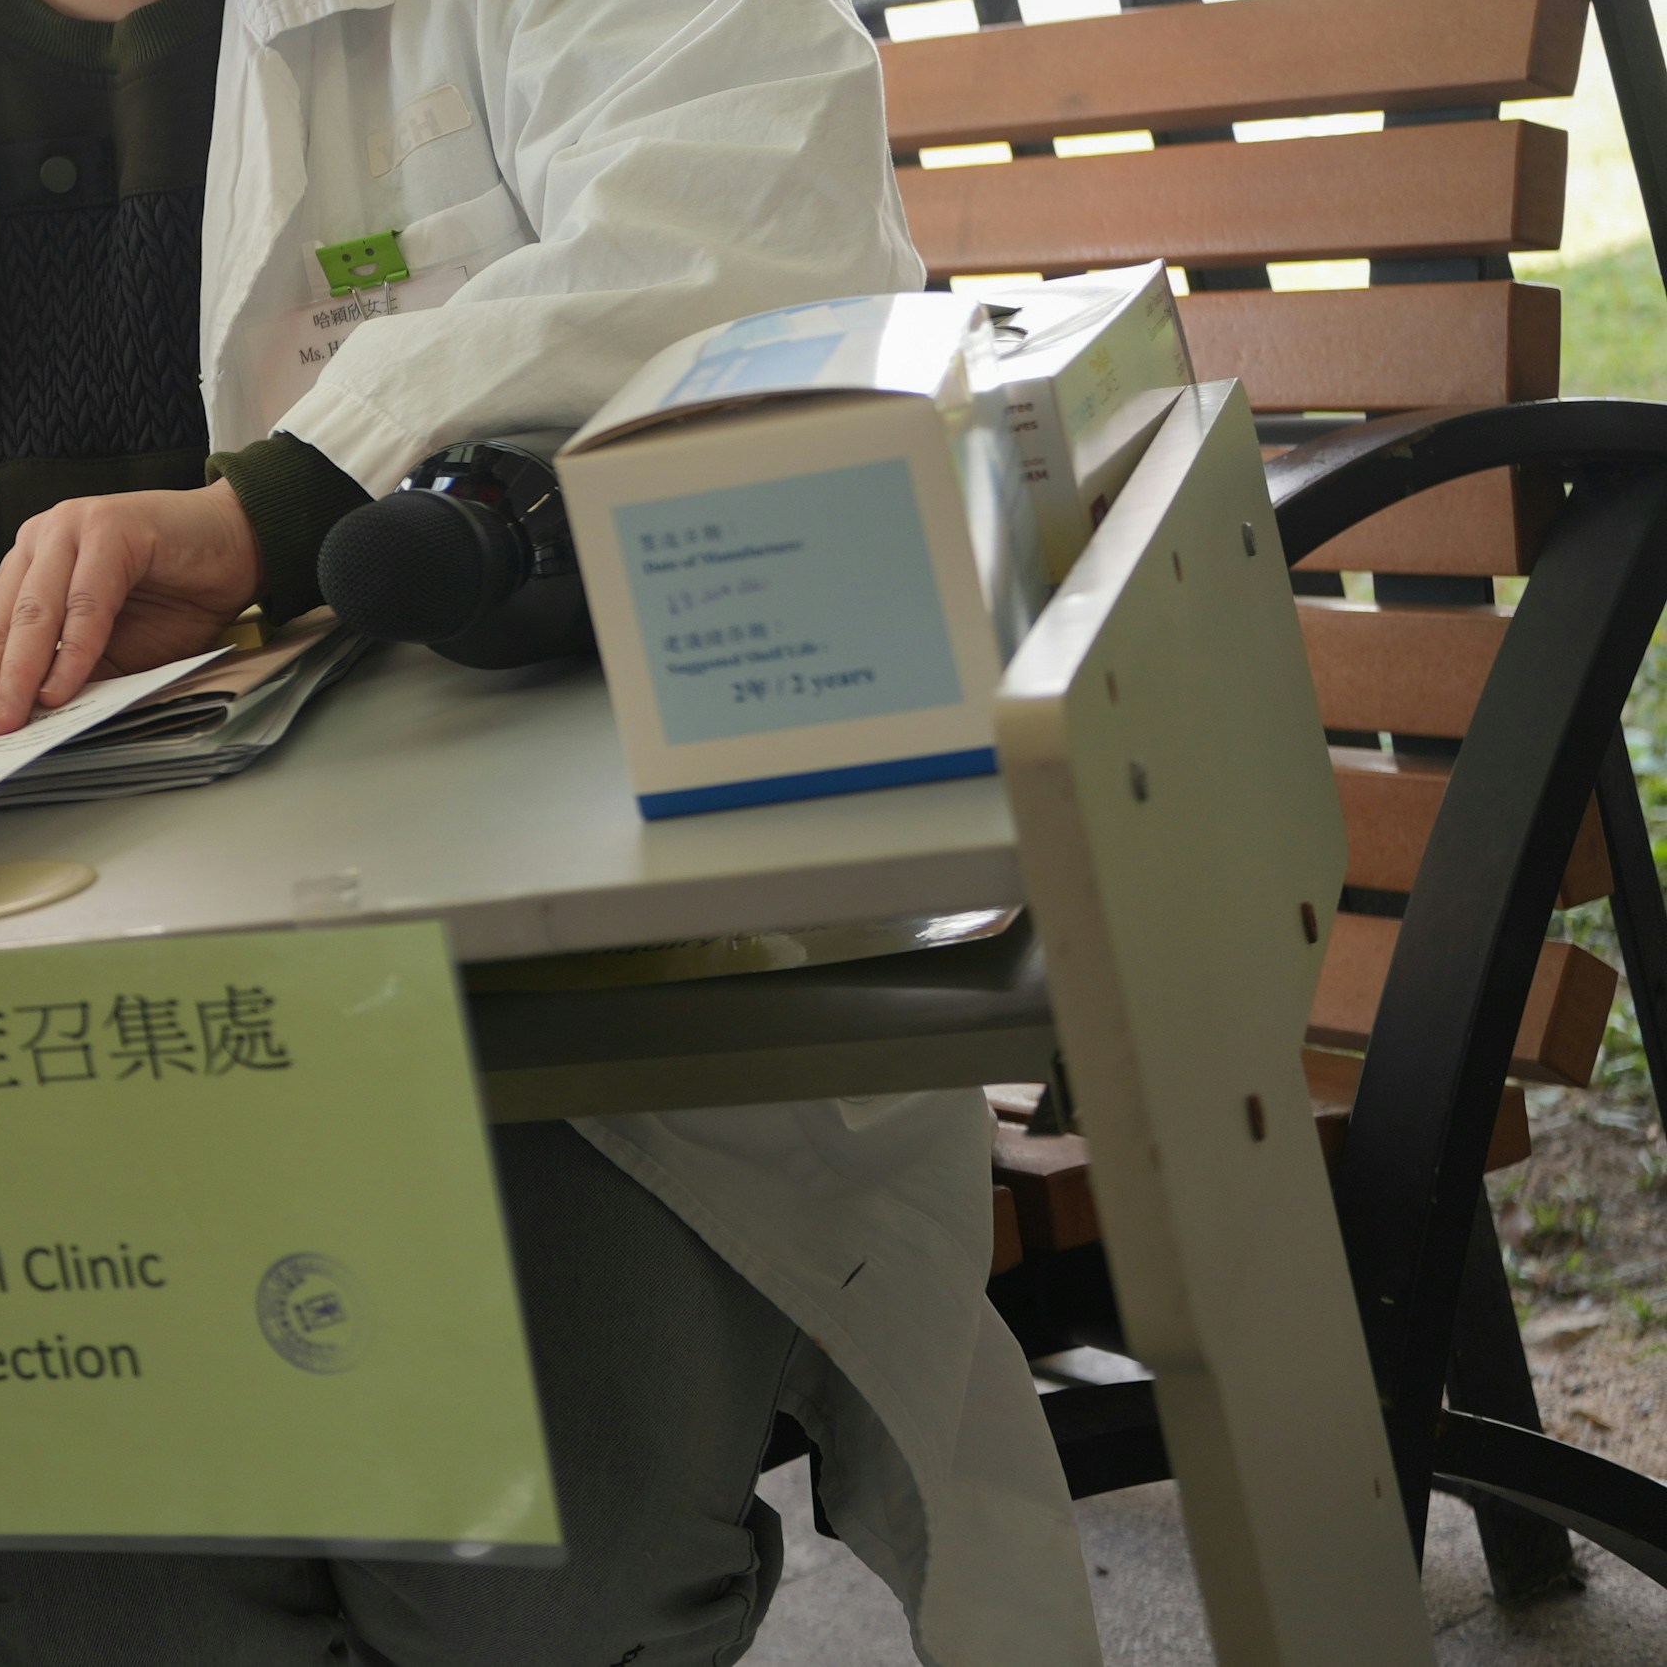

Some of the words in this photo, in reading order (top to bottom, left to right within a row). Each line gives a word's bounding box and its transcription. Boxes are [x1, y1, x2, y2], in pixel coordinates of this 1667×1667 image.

[299, 346, 325, 365] Ms.
[810, 668, 875, 698] years
[23, 1242, 165, 1293] Clinic
